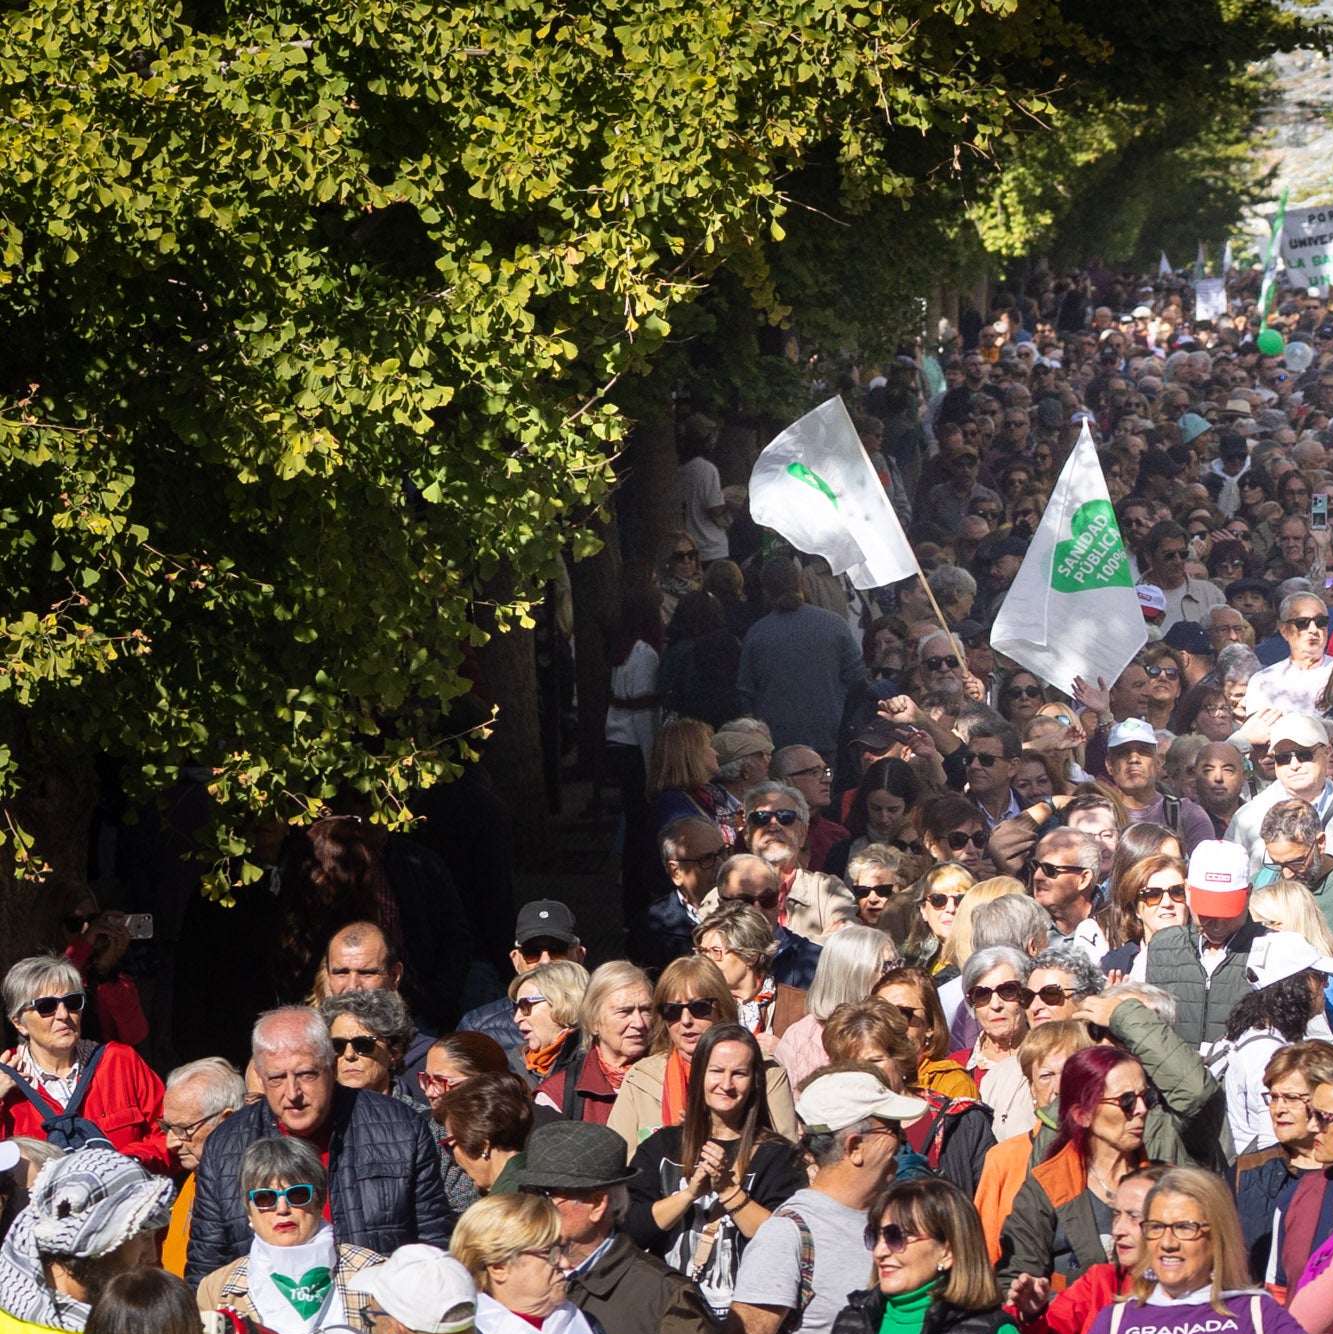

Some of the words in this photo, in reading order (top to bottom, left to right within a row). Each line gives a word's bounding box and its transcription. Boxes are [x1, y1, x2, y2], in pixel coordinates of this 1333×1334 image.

[1287, 256, 1306, 269] LA
[1057, 514, 1109, 578] SANIDAD
[1073, 526, 1121, 584] PÚBLICA
[1096, 547, 1127, 582] 100%
